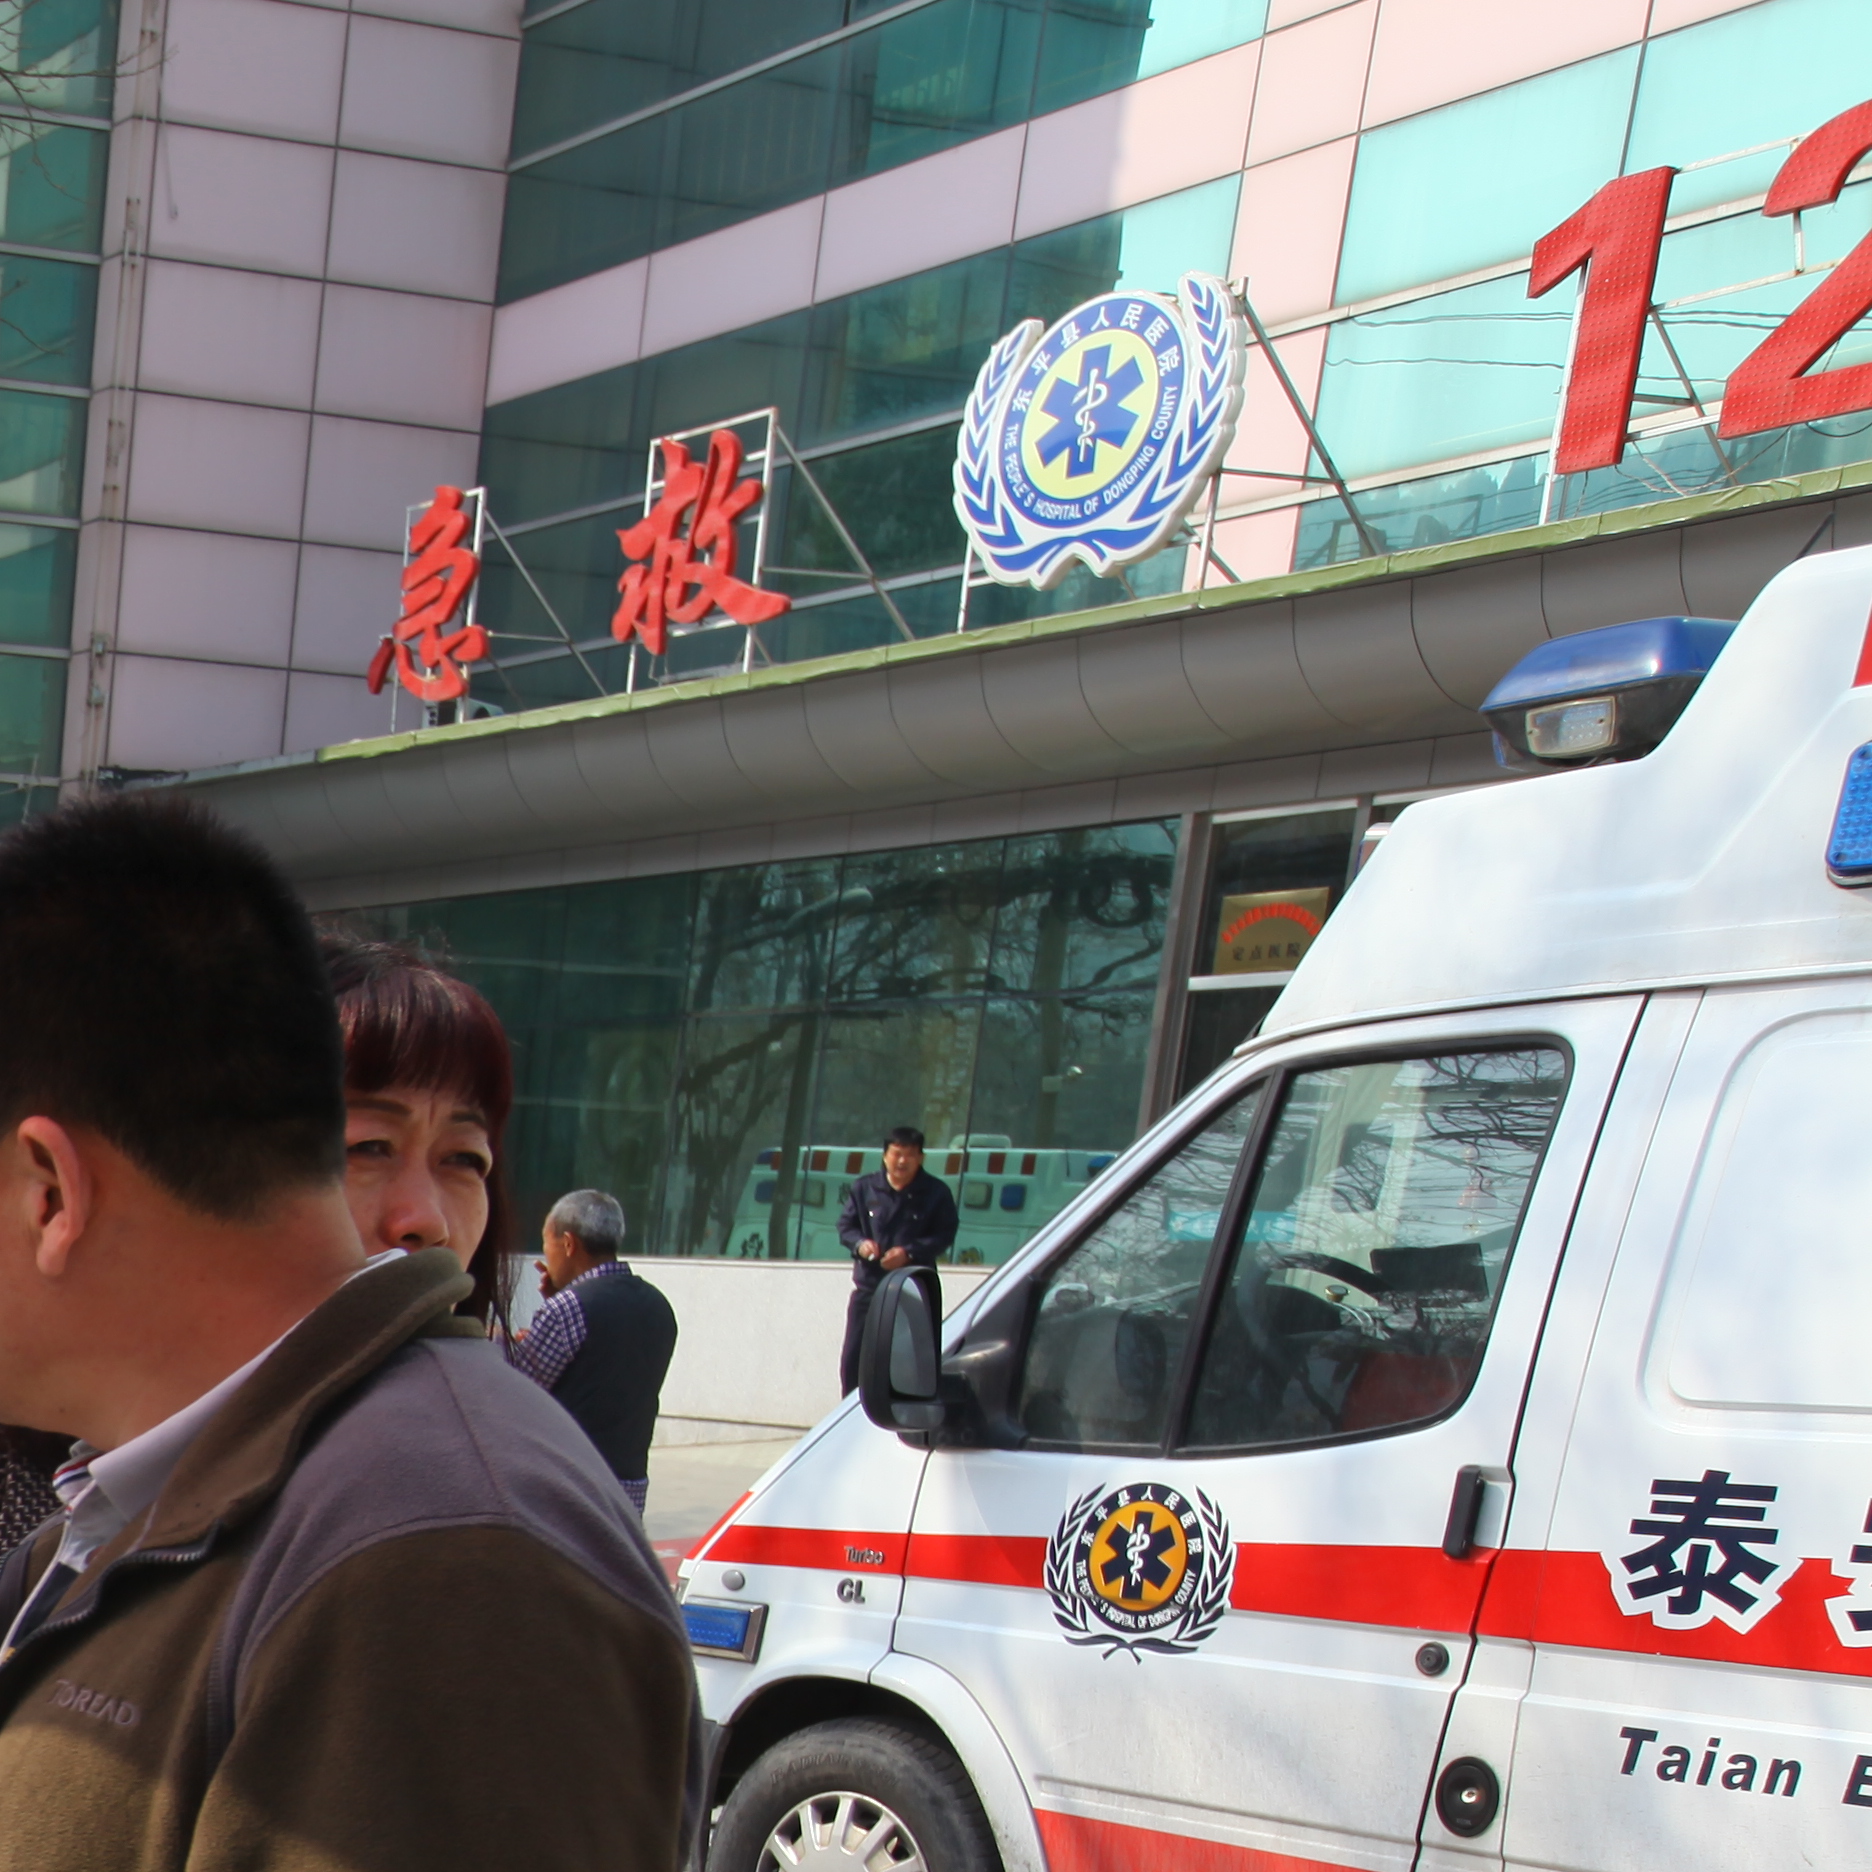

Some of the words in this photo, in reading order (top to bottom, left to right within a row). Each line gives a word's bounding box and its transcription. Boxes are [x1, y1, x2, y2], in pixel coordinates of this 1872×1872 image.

[1012, 302, 1181, 413] 东平县人民医院
[1004, 423, 1019, 450] THE
[1033, 498, 1083, 520] HOSPITAL
[1084, 496, 1100, 514] OF
[1103, 446, 1156, 505] DONGPING
[1151, 385, 1178, 441] COUNTY
[844, 1545, 885, 1565] Turbo
[1080, 1485, 1203, 1556] 东平县人民医院
[836, 1577, 866, 1604] GL
[1619, 1726, 1802, 1798] Taian
